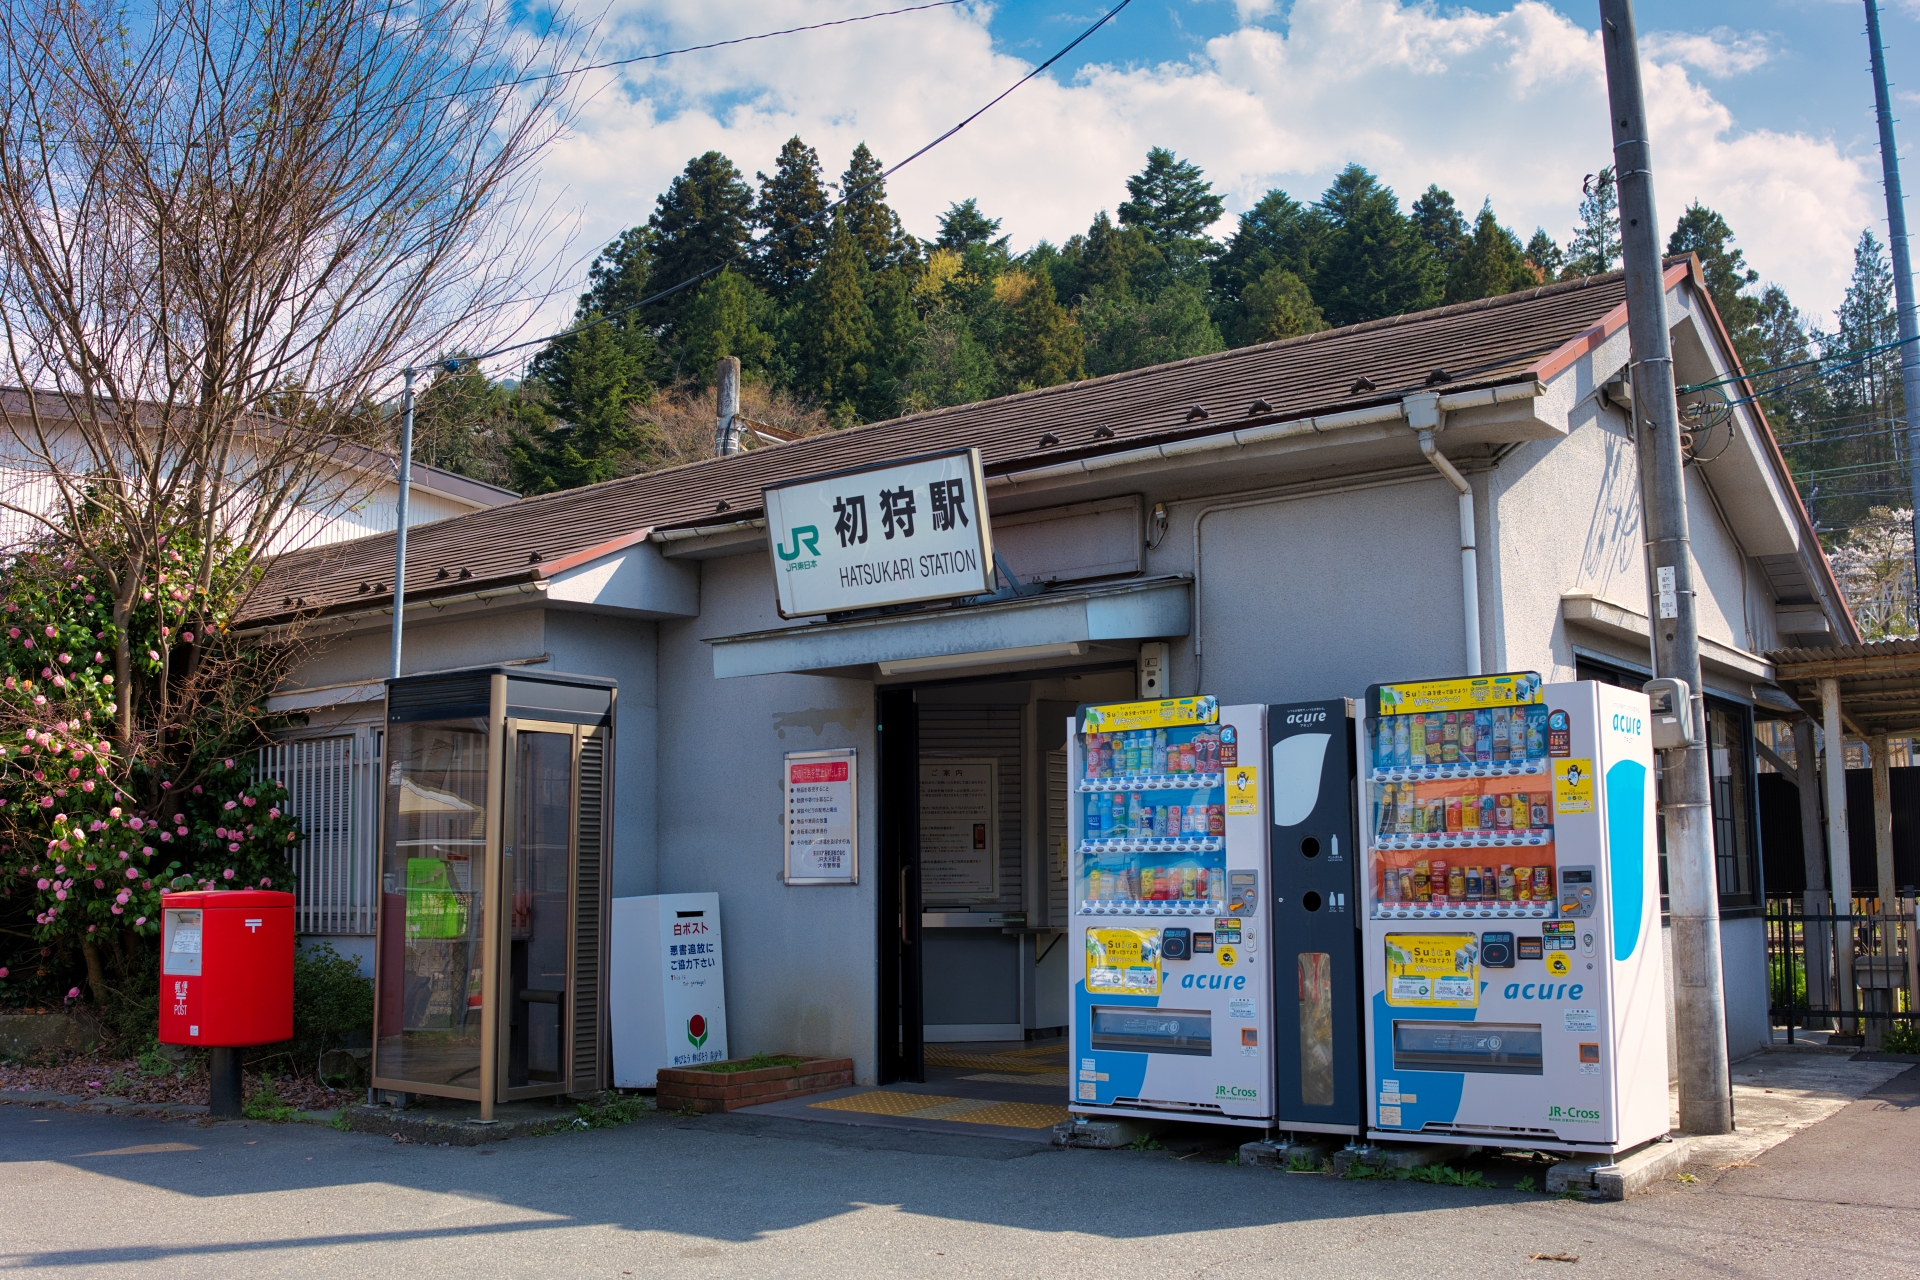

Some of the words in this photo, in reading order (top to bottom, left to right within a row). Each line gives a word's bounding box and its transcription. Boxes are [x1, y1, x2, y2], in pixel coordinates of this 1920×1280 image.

[833, 477, 969, 548] 初狩駅
[777, 524, 821, 562] JR
[785, 559, 818, 572] JR東日本
[839, 558, 915, 588] HATSUKARI
[919, 548, 977, 577] STATION
[1414, 696, 1461, 707] Wキャンペーン
[1113, 716, 1151, 726] Wキャンペーン
[1286, 712, 1326, 724] acure
[1612, 713, 1642, 736] acure
[931, 769, 963, 777] ご案内
[673, 921, 709, 936] 白ポスト
[669, 943, 714, 956] 悪書追放に
[1108, 940, 1138, 949] Suica
[1414, 947, 1451, 956] Suica
[670, 957, 716, 971] ご協力下さい
[174, 981, 188, 994] 郵便
[1181, 973, 1246, 991] acure
[1504, 981, 1584, 1000] acure
[173, 1004, 187, 1016] POST
[1215, 1085, 1257, 1097] JR-Cross
[1548, 1106, 1600, 1119] JR-Cross
